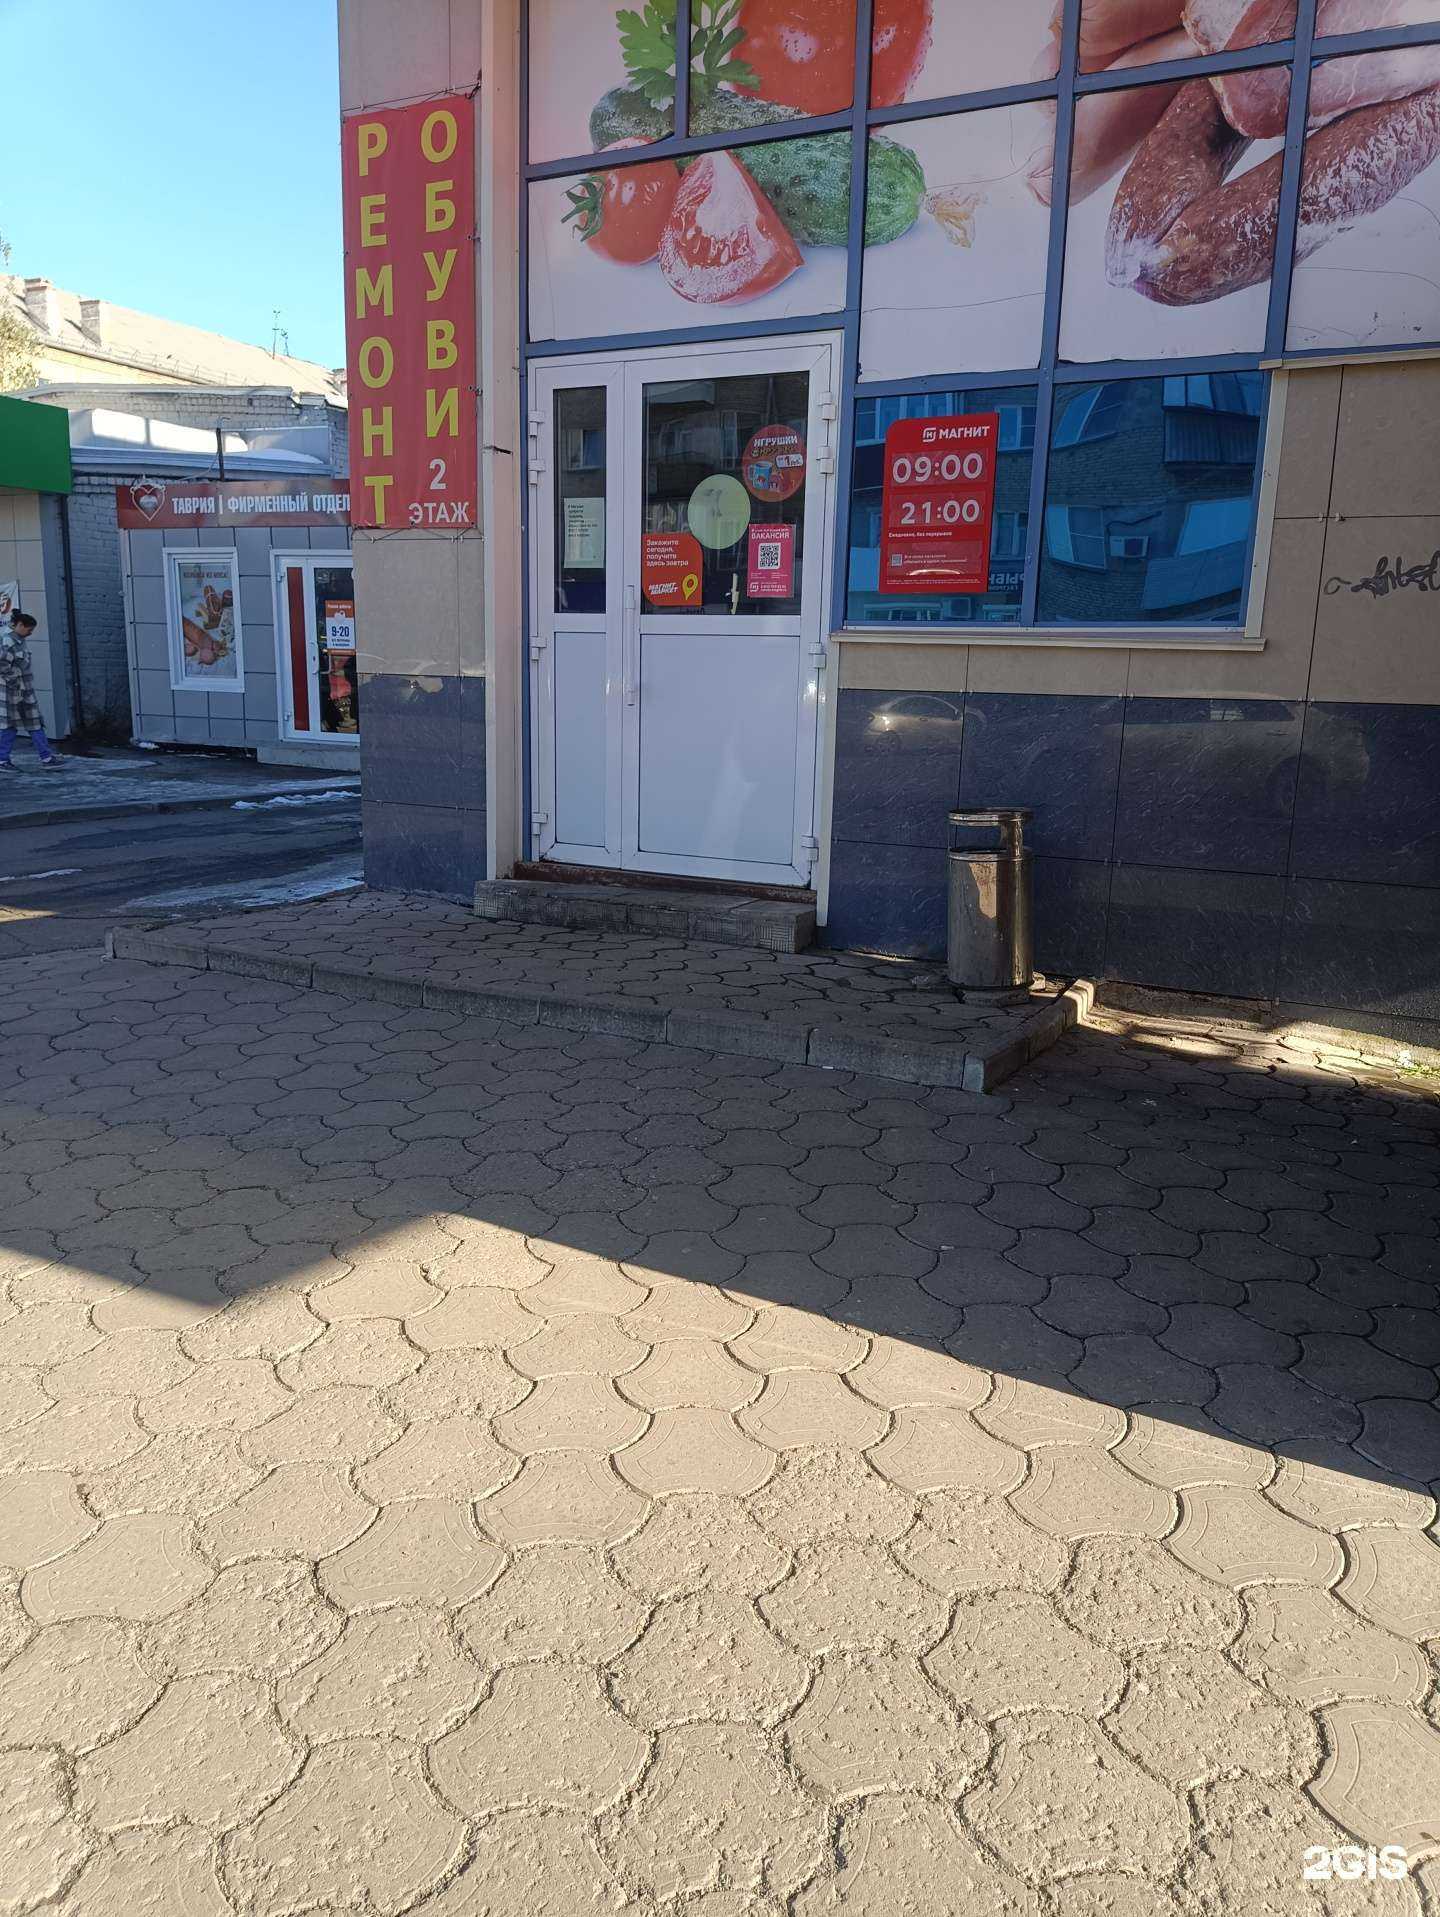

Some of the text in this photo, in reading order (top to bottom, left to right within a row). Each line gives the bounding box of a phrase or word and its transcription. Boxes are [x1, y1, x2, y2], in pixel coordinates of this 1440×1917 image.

[420, 110, 459, 438] ОБУВИ
[356, 122, 394, 525] РЕМОНТ
[753, 435, 798, 448] ИГРУШКИ
[939, 425, 990, 439] МАГНИТ
[429, 458, 447, 491] 2
[892, 453, 983, 483] 09:00
[172, 492, 350, 514] ТАВРИЯ ФИРМЕННЫЙ ОТДЕЛ
[408, 501, 470, 524] ЭТАЖ
[901, 500, 980, 525] 21:00
[331, 625, 350, 637] 9-20
